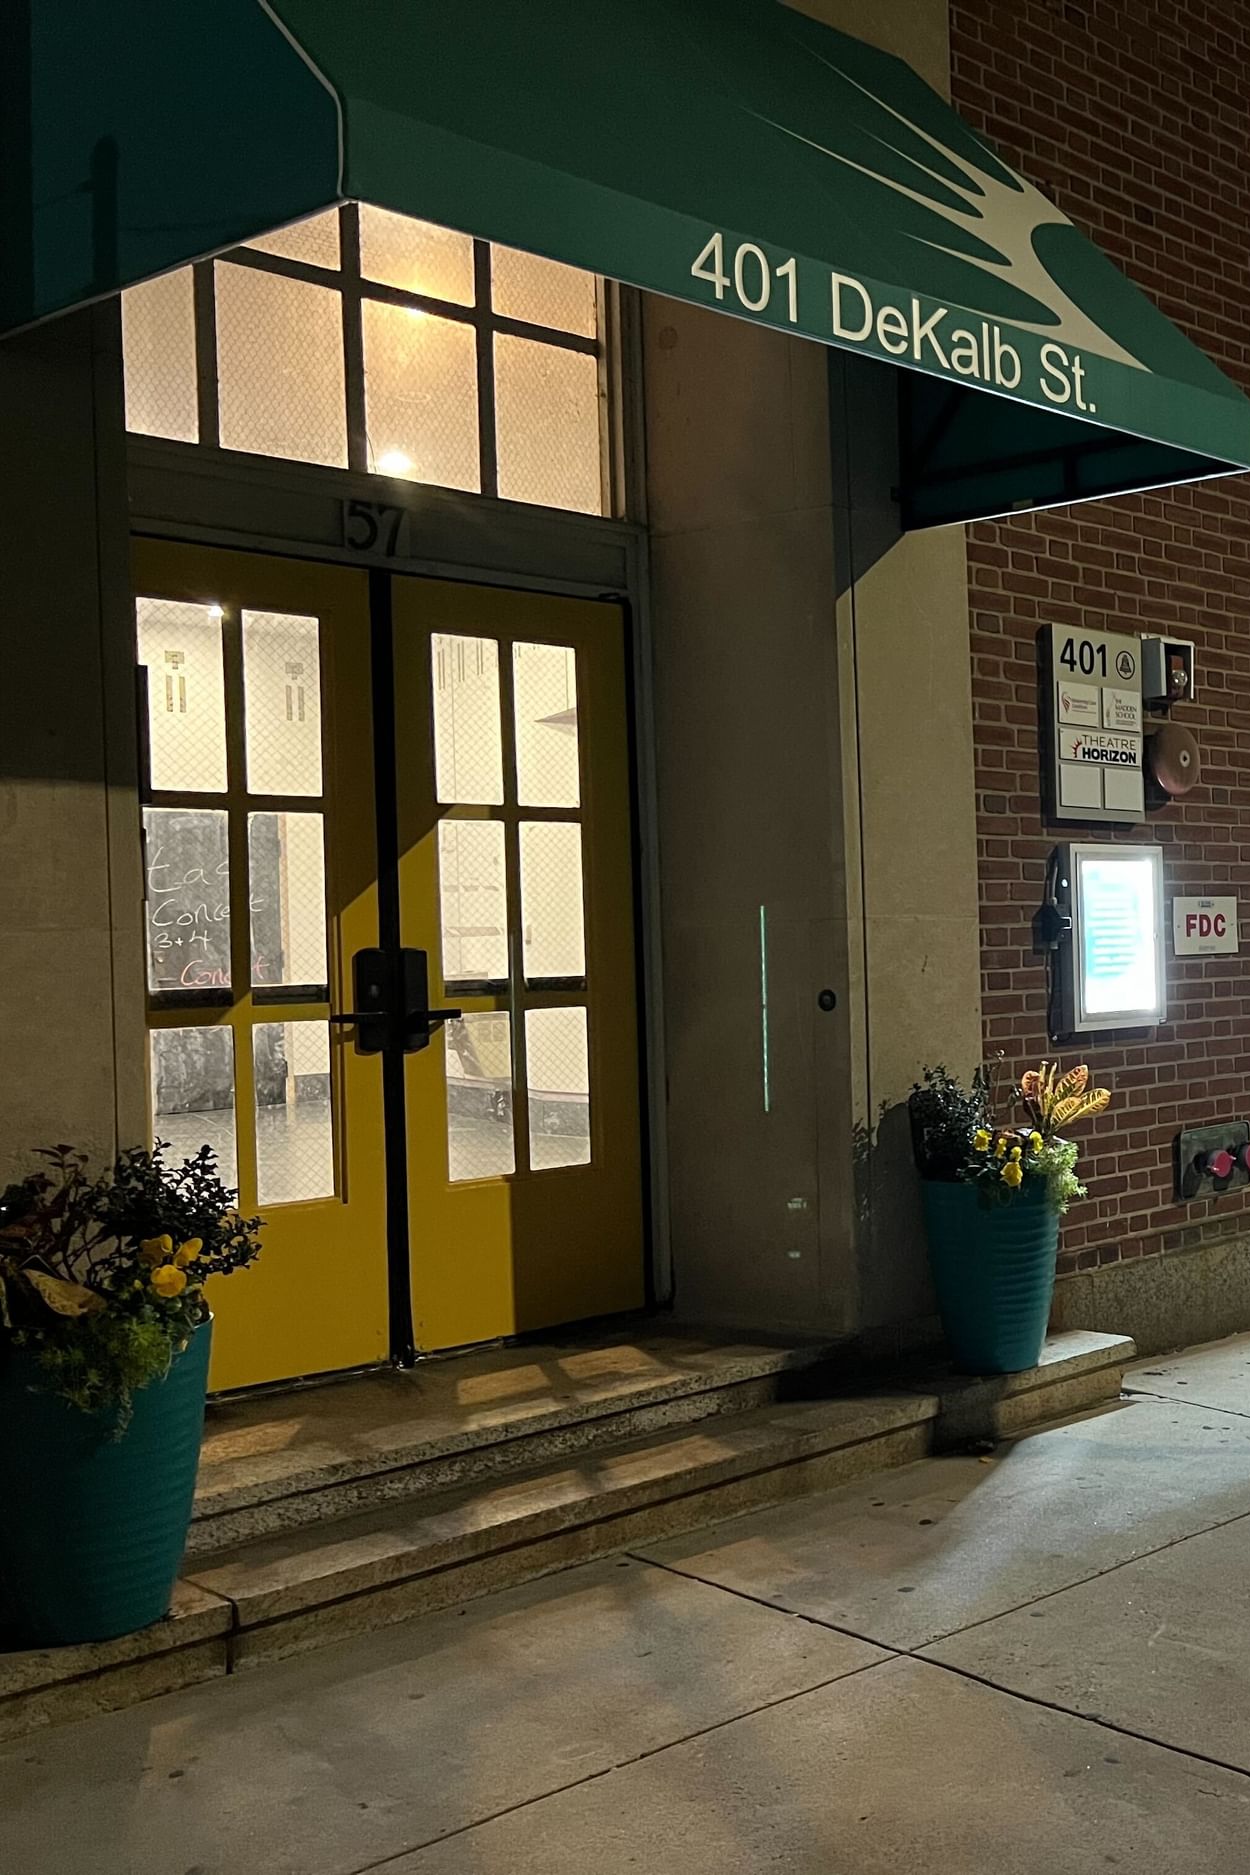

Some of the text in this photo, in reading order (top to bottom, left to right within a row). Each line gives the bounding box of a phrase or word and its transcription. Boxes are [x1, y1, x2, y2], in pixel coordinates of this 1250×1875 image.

[691, 232, 1097, 414] 401 DeKalb St.
[347, 500, 406, 558] 57
[1060, 637, 1107, 678] 401
[1081, 734, 1137, 751] THEATRE
[1082, 747, 1137, 764] HORIZON
[1186, 913, 1226, 938] FDC
